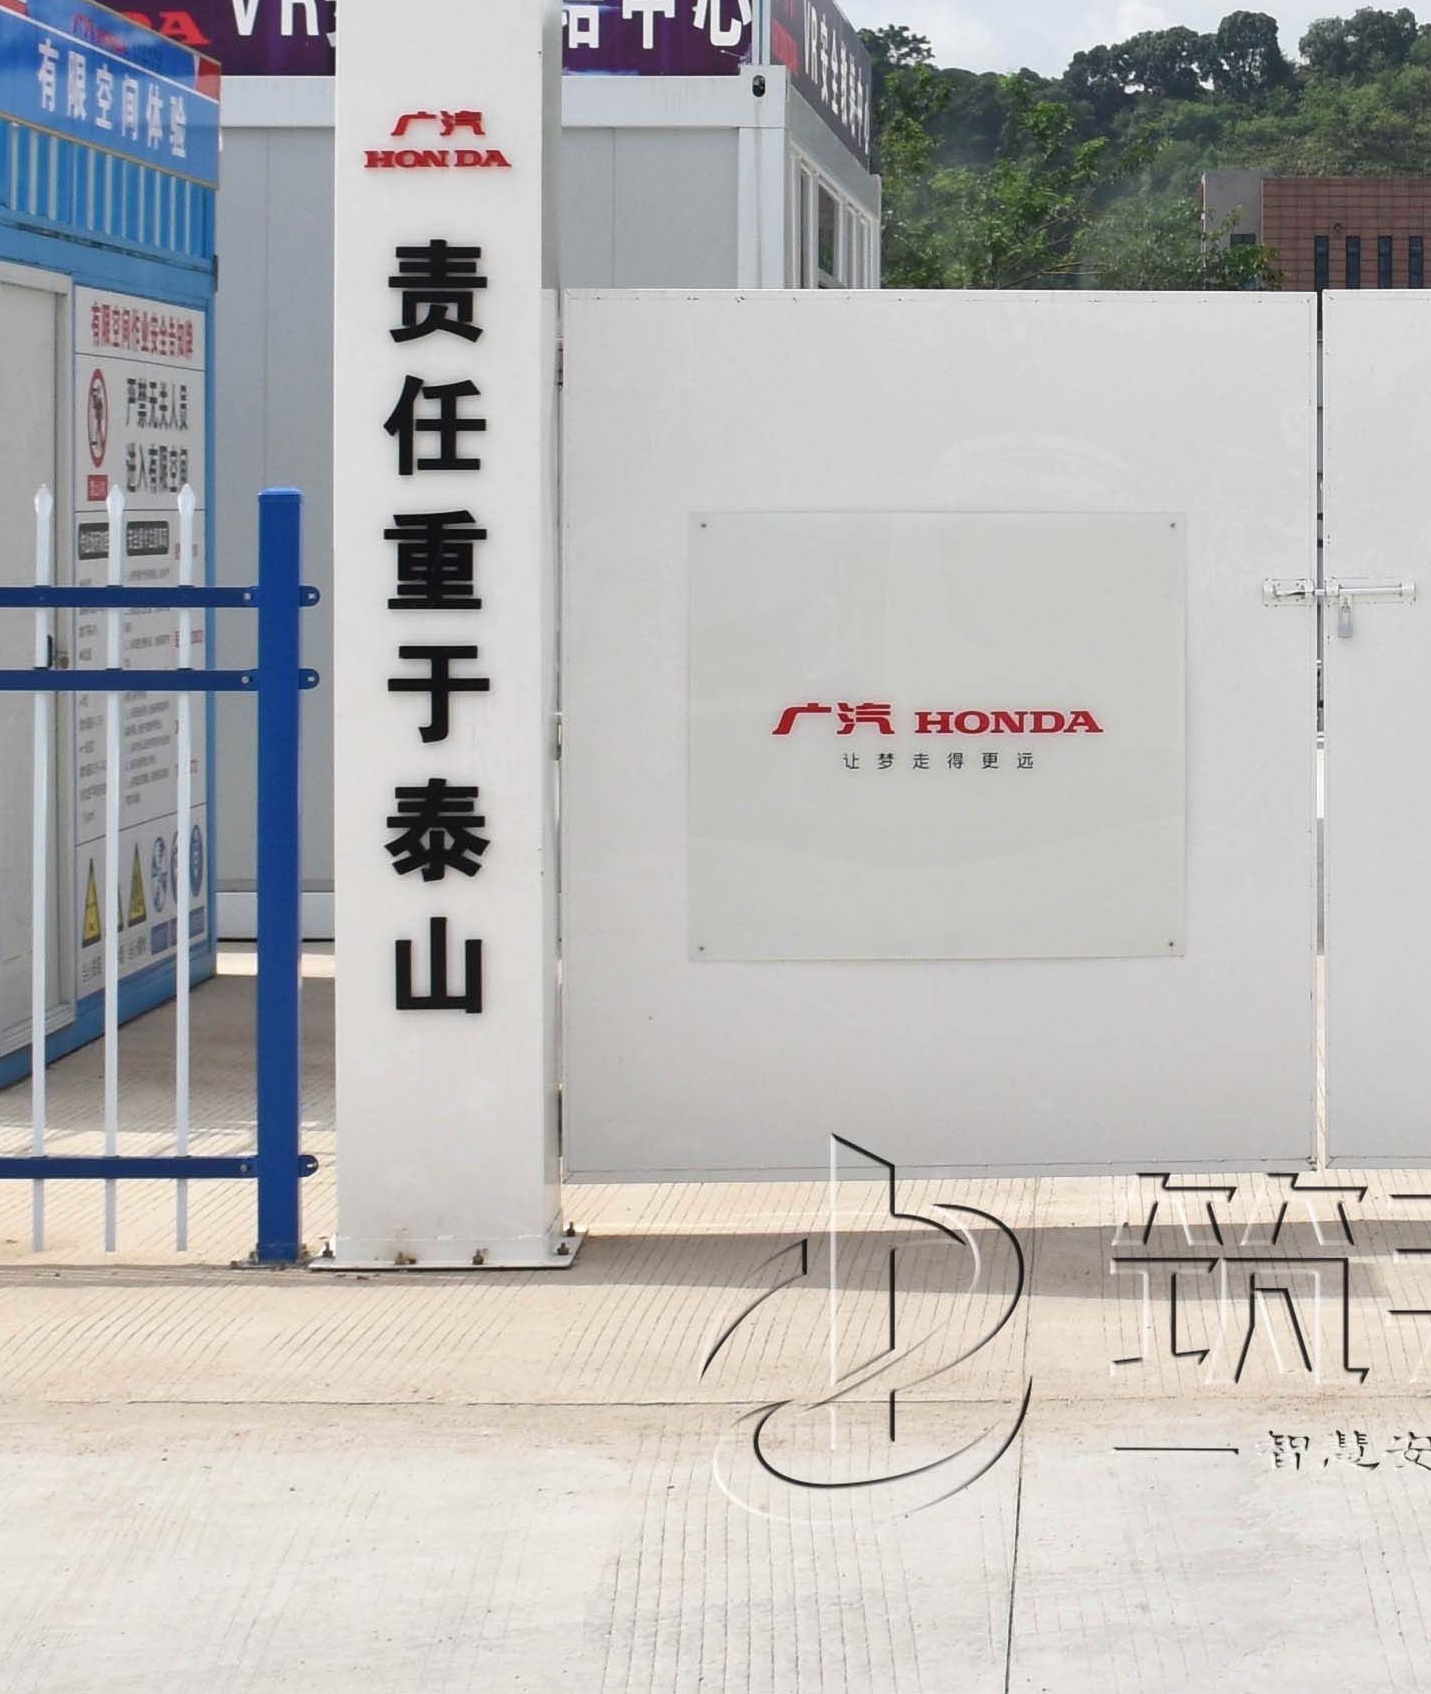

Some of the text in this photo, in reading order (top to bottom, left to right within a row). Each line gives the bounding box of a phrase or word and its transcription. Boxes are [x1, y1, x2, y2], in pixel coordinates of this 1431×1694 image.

[37, 37, 187, 159] 有限空间体验
[391, 110, 485, 137] 广汽
[364, 149, 512, 169] HONDA
[126, 378, 188, 430] 严禁无关人员
[126, 443, 188, 494] 进入有限空间
[383, 239, 491, 1014] 责任重于泰山
[772, 702, 1104, 735] 广汽 HONDA
[842, 751, 1034, 770] 让梦走得更远
